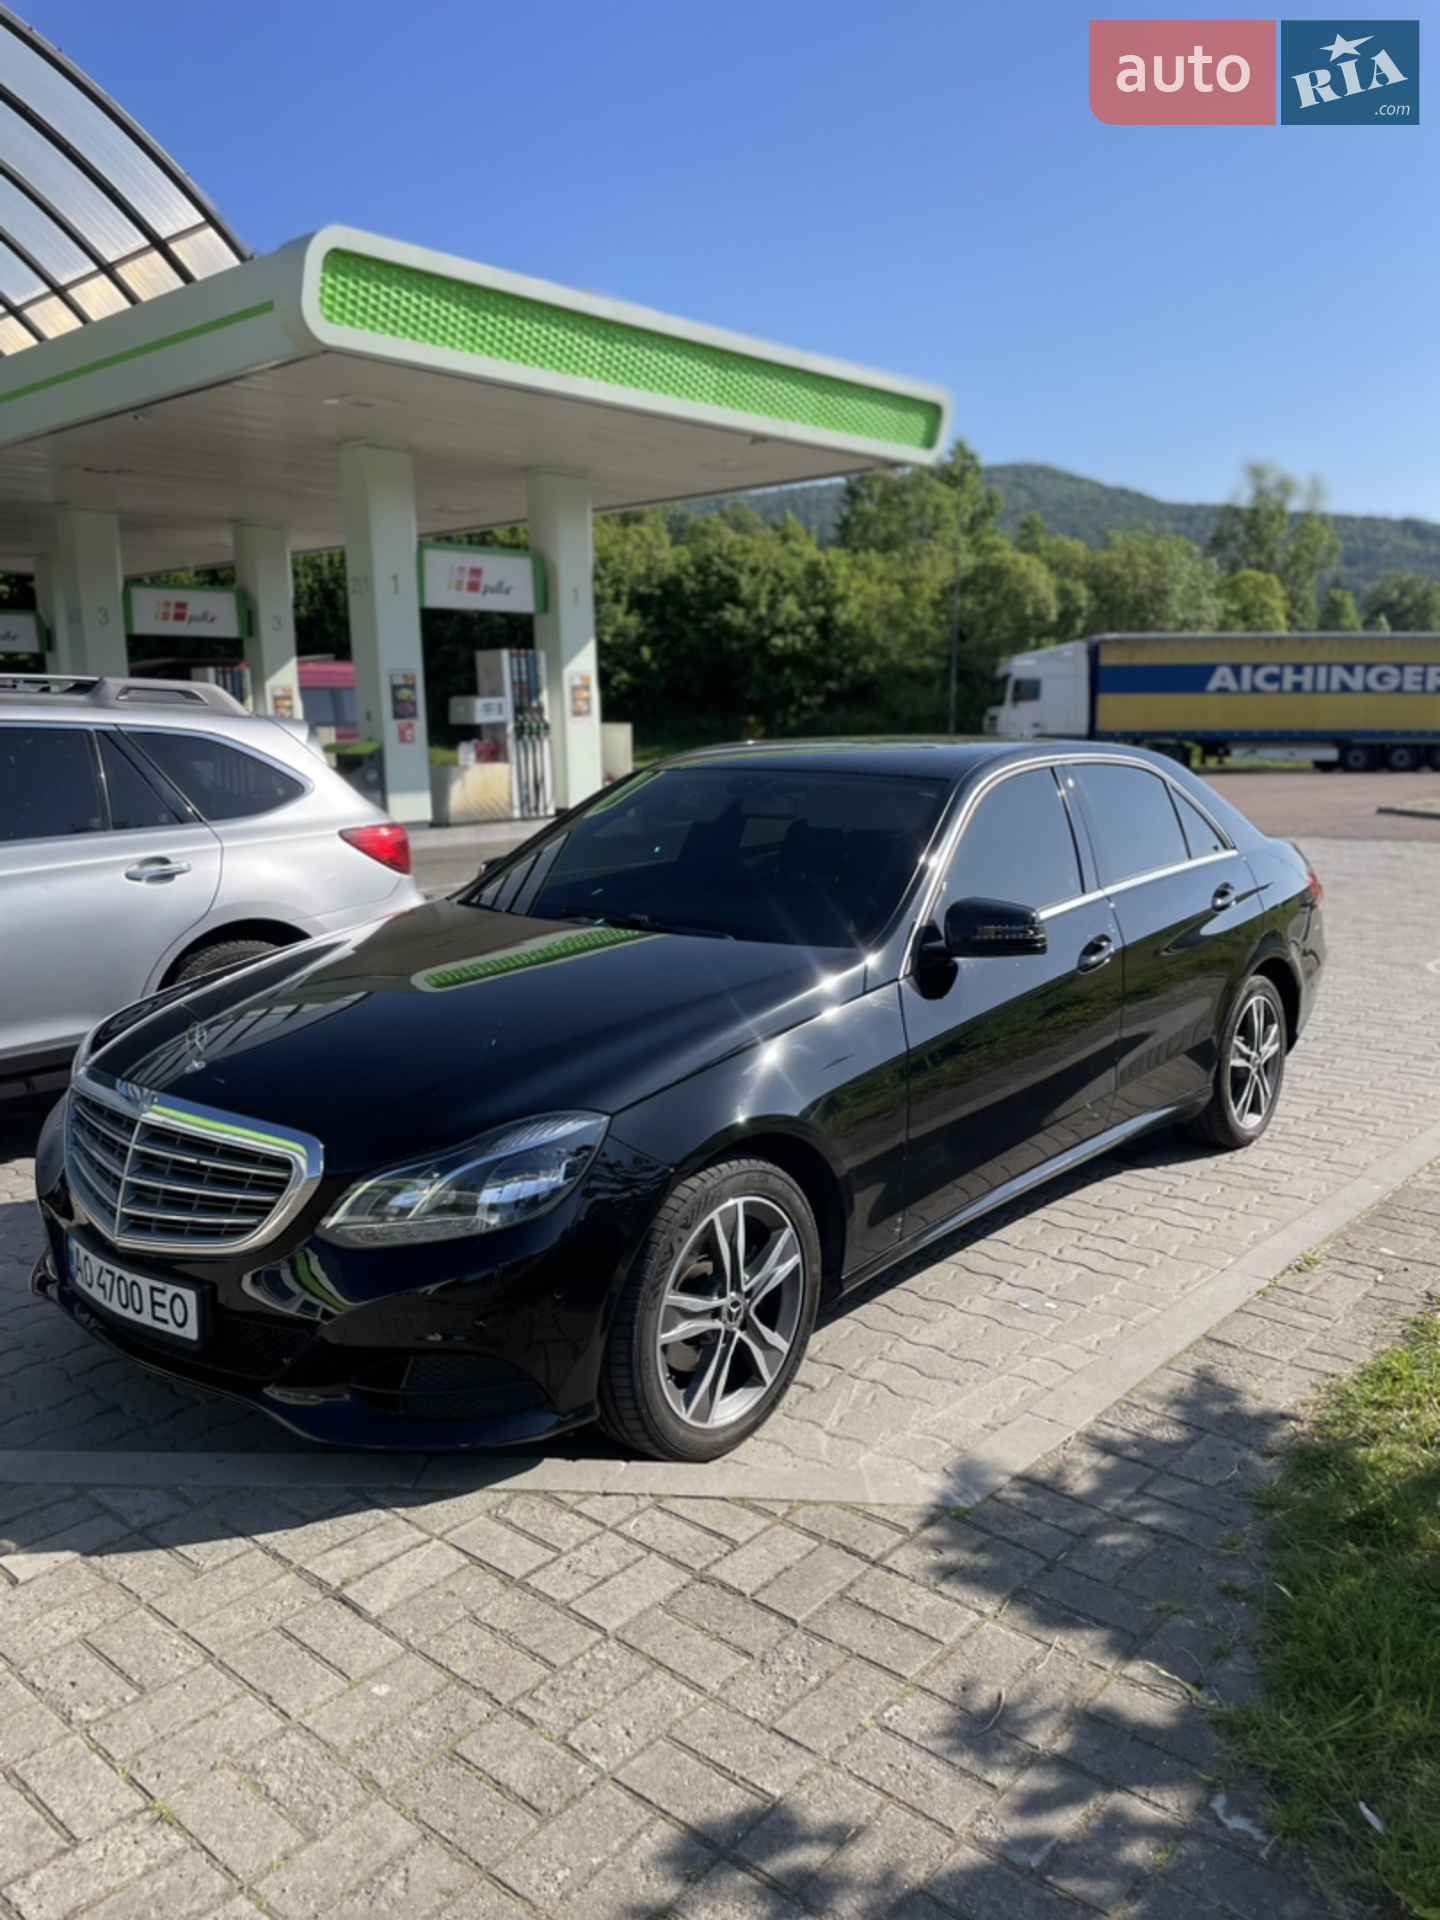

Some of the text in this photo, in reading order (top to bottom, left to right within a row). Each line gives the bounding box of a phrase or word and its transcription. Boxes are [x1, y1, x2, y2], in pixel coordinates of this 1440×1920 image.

[390, 573, 399, 595] 1
[97, 607, 110, 625] 3
[271, 615, 282, 632] 3
[97, 1265, 143, 1315] 4700
[149, 1285, 188, 1329] EO
